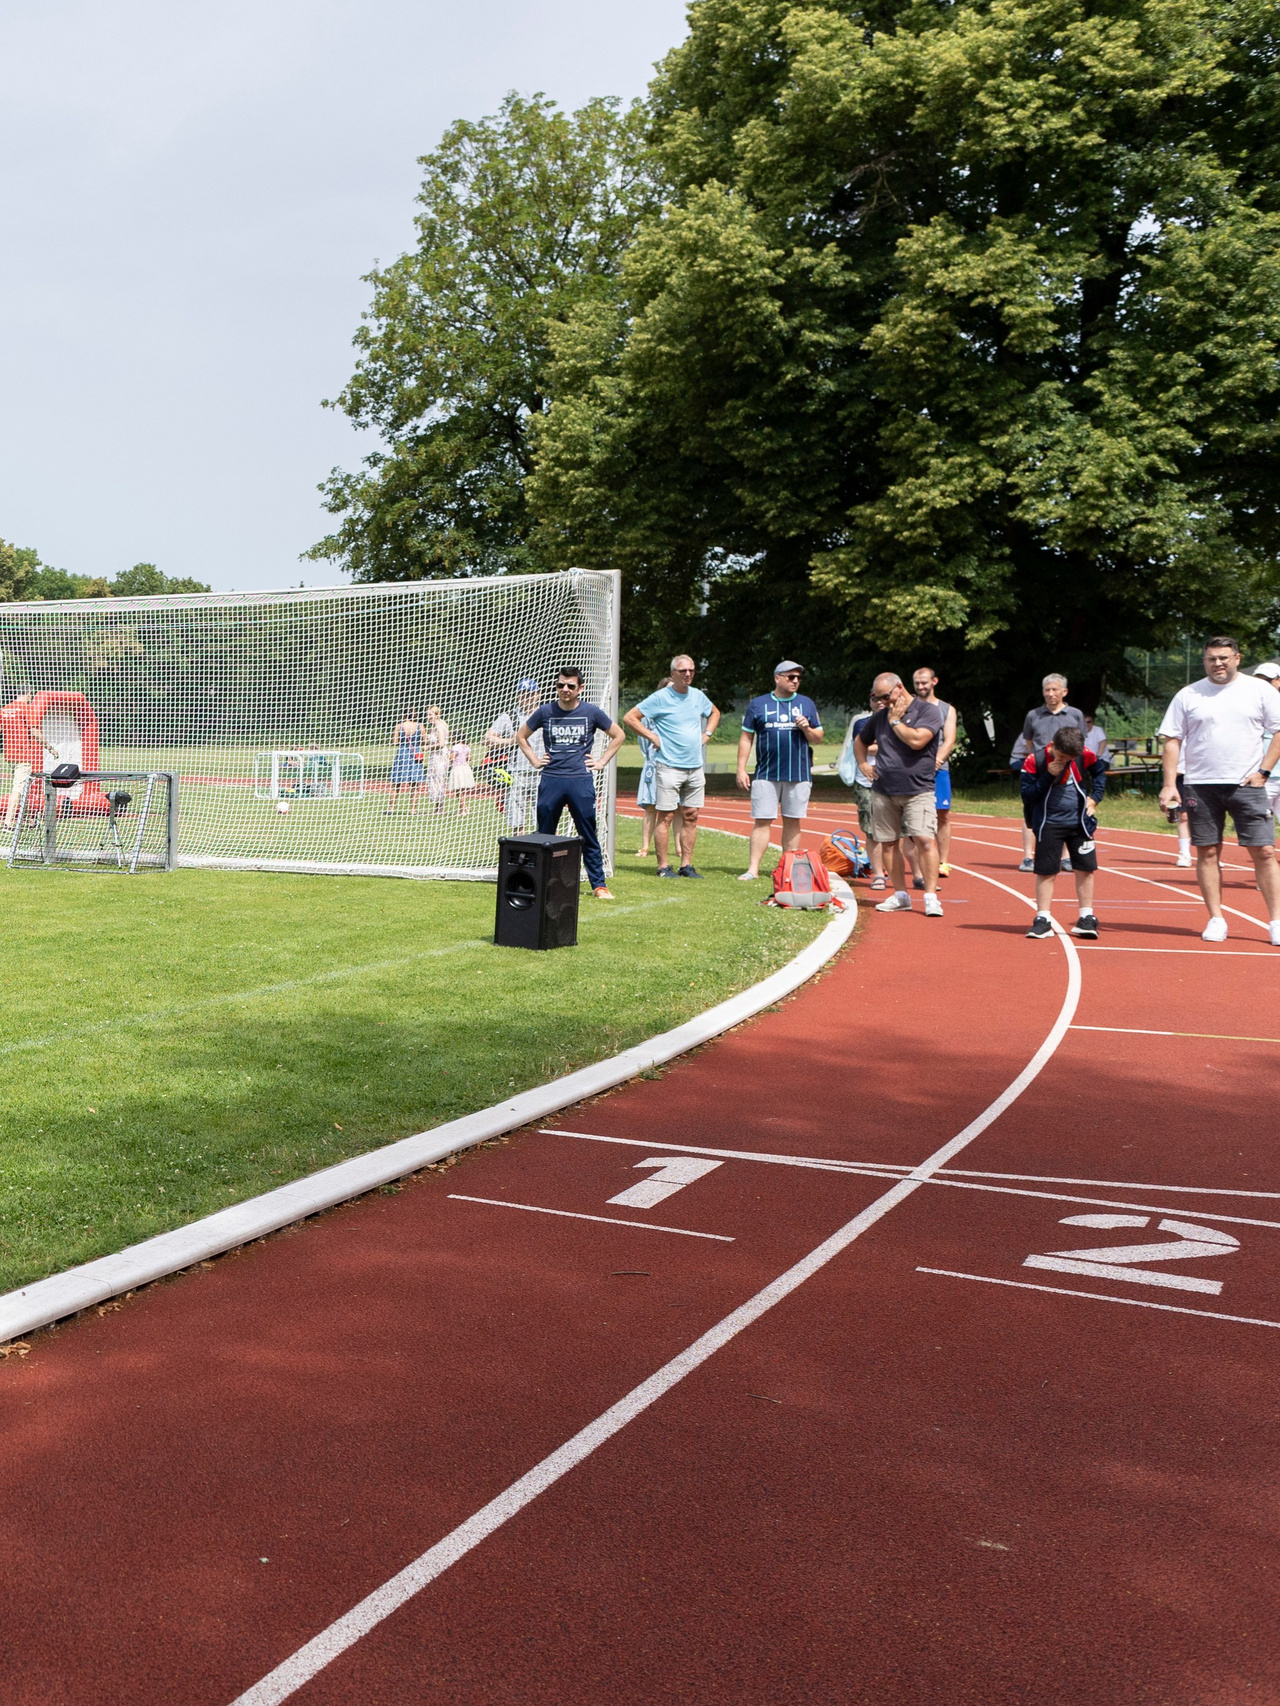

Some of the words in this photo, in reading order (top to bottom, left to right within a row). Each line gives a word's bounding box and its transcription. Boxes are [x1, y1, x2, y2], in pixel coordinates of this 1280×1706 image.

[551, 726, 585, 736] BOAZN
[605, 1156, 725, 1209] 1
[1022, 1213, 1241, 1296] 2
